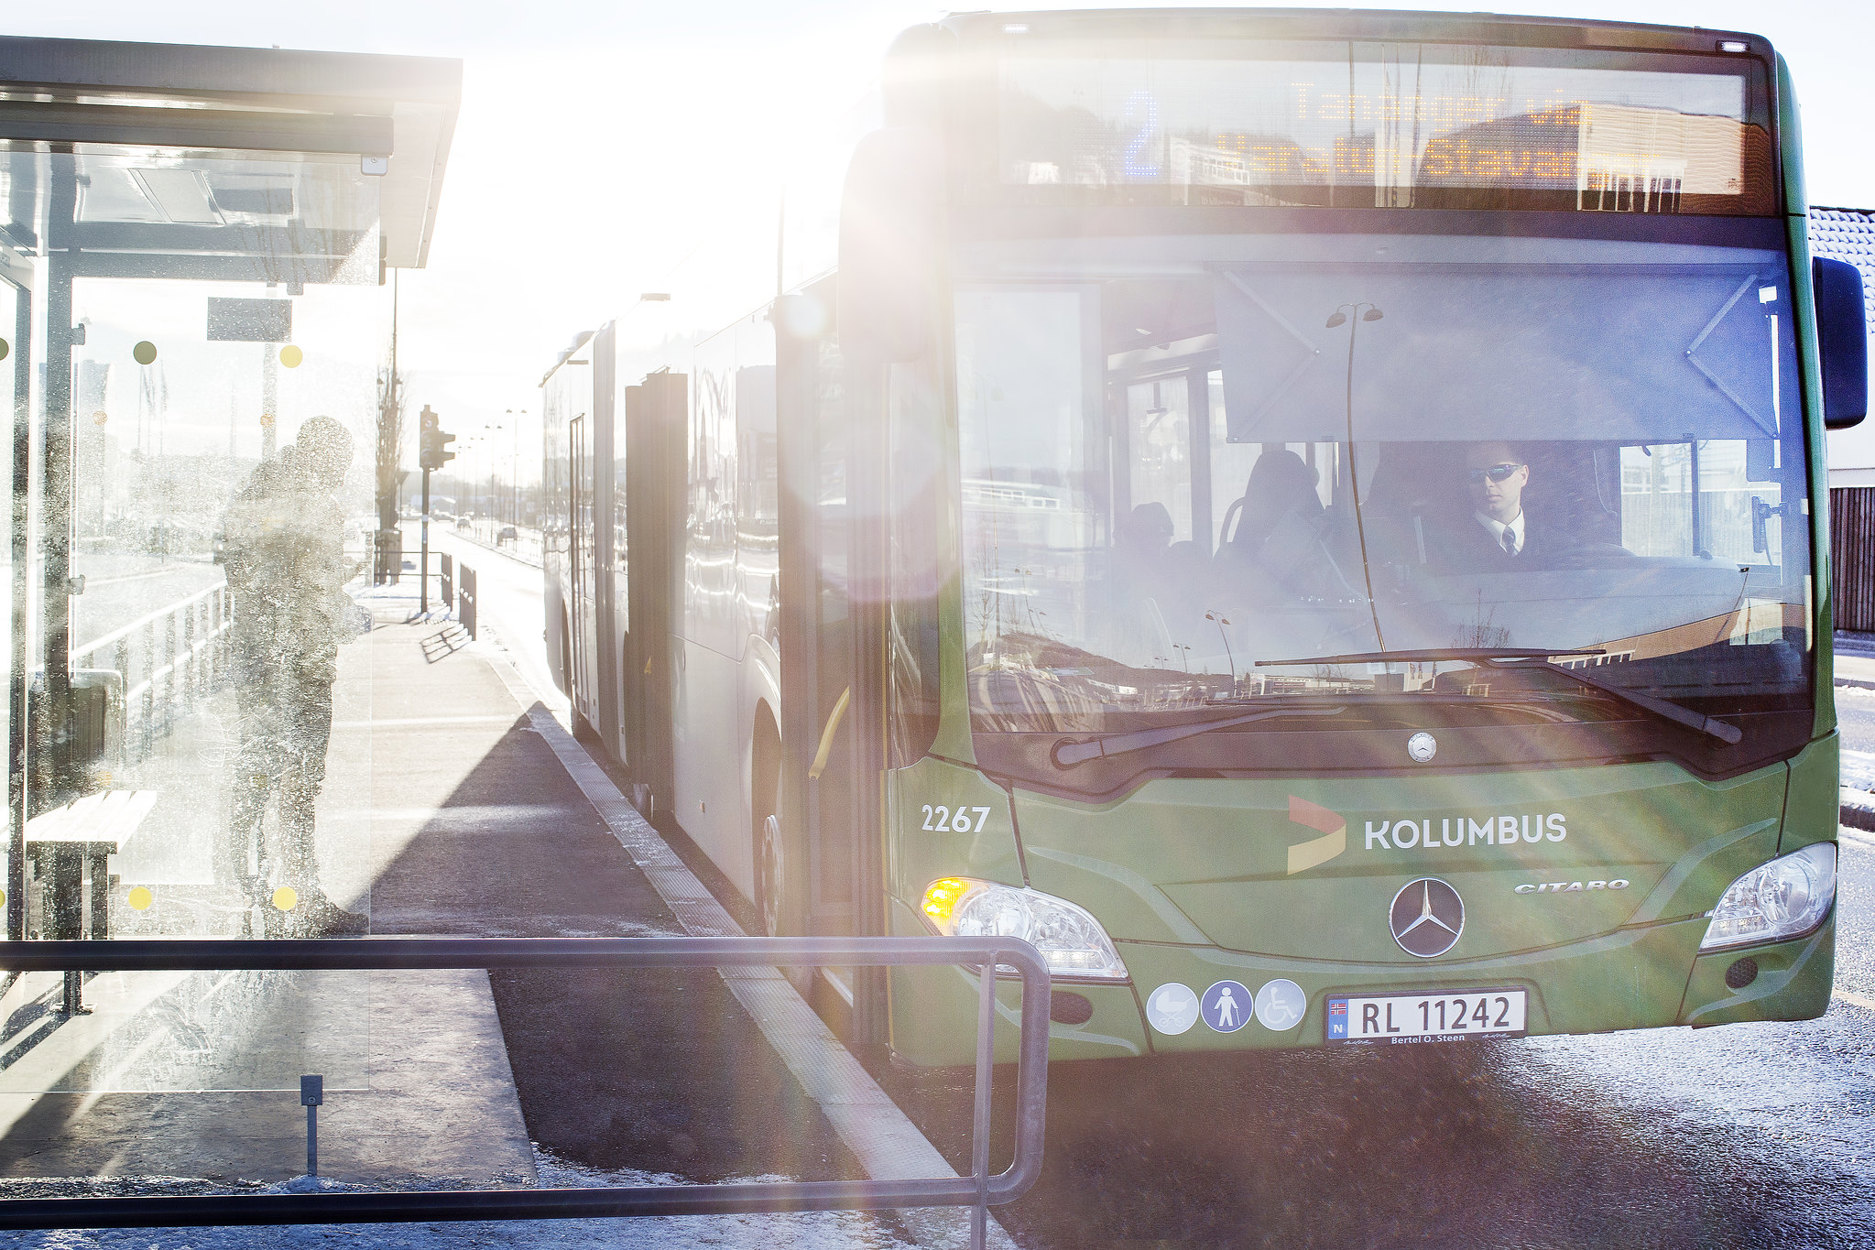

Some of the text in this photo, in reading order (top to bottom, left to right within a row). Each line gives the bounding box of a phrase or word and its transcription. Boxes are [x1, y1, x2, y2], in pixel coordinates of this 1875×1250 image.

[1291, 83, 1593, 132] Tananger via
[1126, 91, 1157, 175] 2
[921, 804, 991, 833] 2267
[1365, 813, 1567, 850] KOLUMBUS
[1514, 879, 1630, 895] CITARO
[1333, 1024, 1343, 1034] N
[1362, 996, 1510, 1034] RL 11242
[1391, 1034, 1465, 1045] Bertel O. Steen
